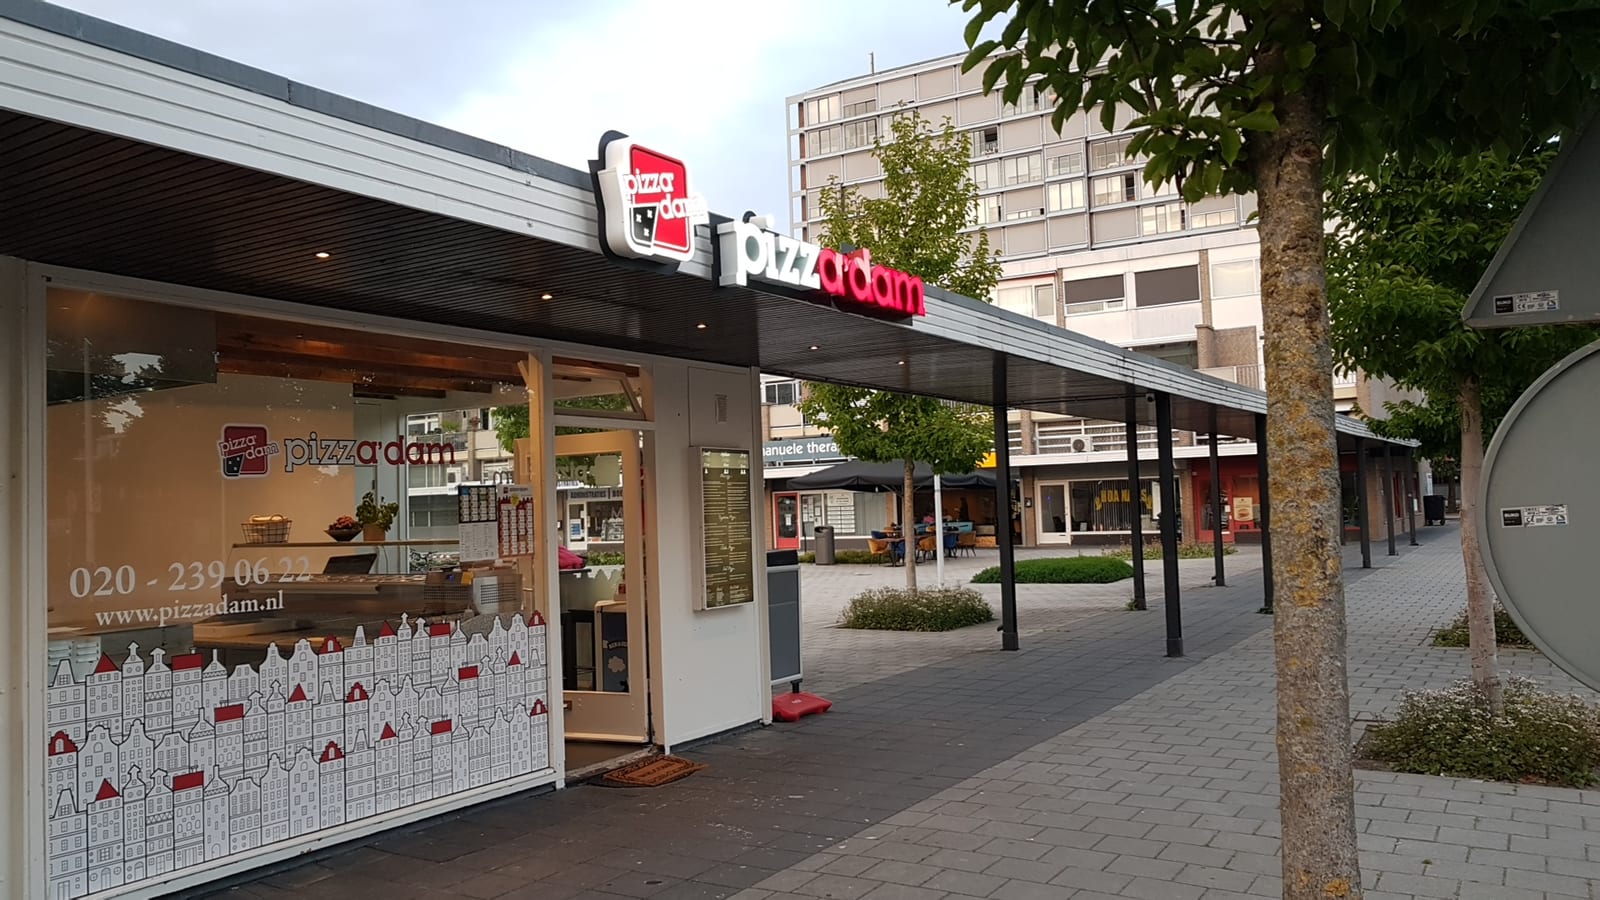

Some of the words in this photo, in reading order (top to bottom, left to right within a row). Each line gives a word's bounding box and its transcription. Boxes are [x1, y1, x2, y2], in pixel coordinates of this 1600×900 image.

[660, 193, 708, 222] dam
[245, 443, 279, 460] dam
[807, 441, 840, 454] thera
[69, 564, 136, 598] 020
[168, 559, 225, 591] 239
[233, 557, 270, 586] 06
[278, 555, 312, 583] 22
[94, 590, 285, 628] www.pizzadam.nl
